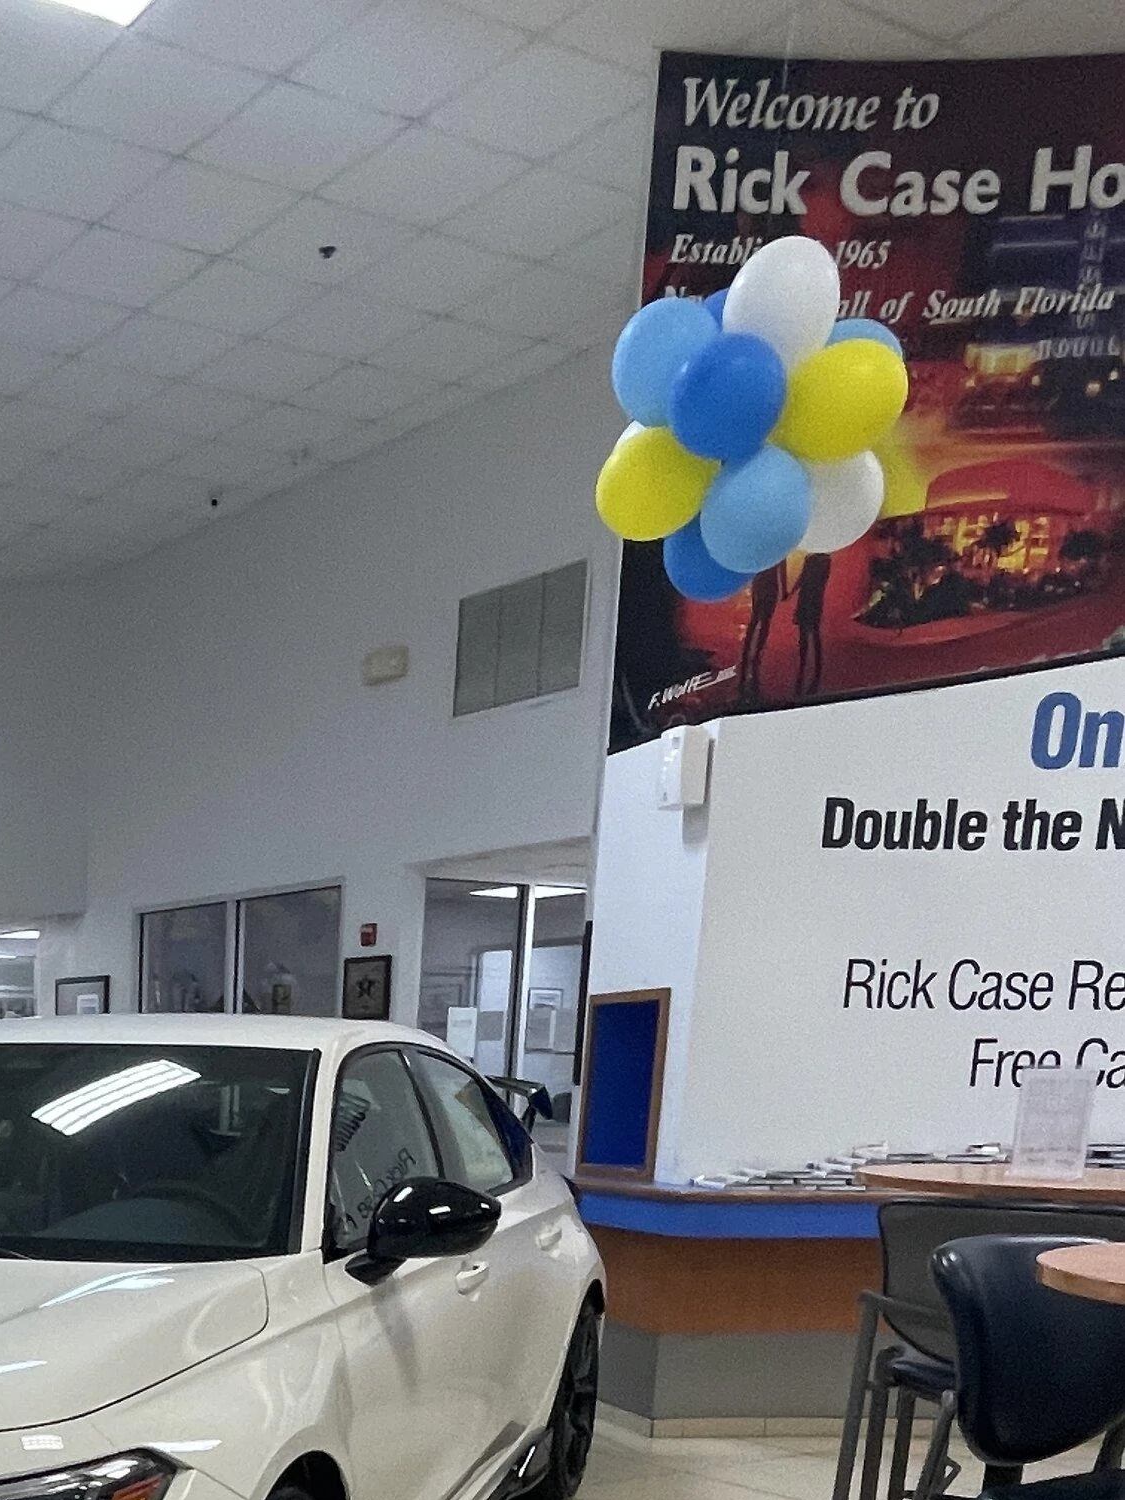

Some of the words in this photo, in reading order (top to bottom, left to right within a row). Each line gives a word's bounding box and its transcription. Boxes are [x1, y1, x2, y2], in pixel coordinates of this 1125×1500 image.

[683, 77, 880, 131] Welcome
[892, 86, 940, 131] to
[673, 145, 811, 215] Rick
[839, 150, 1001, 217] Case
[1029, 144, 1125, 212] Ho
[836, 239, 892, 270] 1965
[879, 290, 916, 324] of
[922, 289, 1001, 319] South
[1012, 283, 1116, 315] Florida
[821, 796, 988, 851] Double
[1002, 798, 1083, 851] the
[843, 958, 939, 1010] Rick
[948, 958, 1054, 1011] Case
[1068, 960, 1125, 1011] Re
